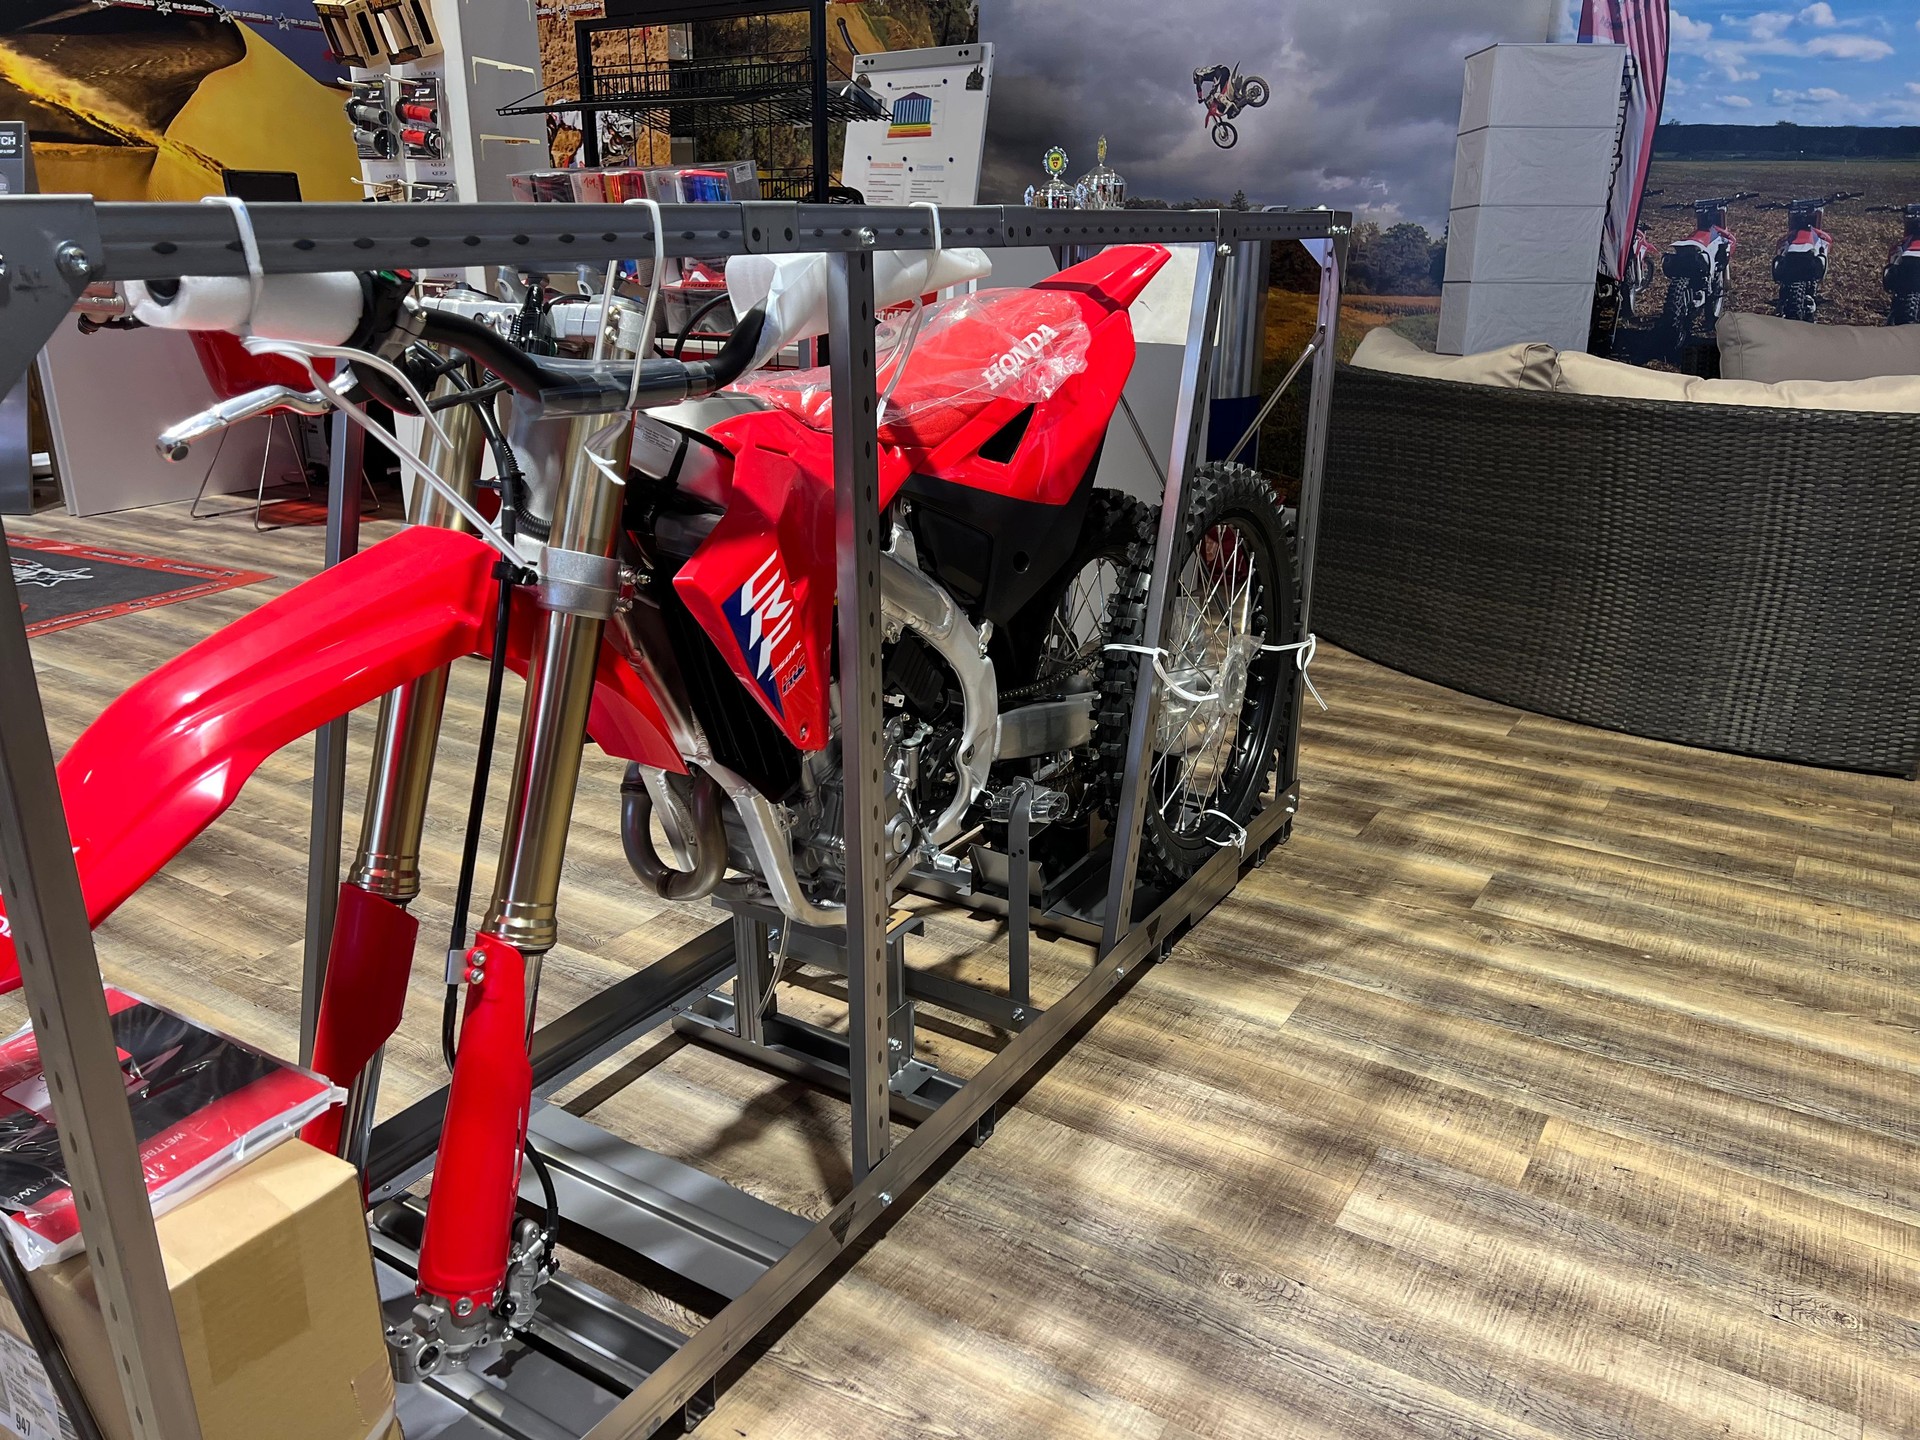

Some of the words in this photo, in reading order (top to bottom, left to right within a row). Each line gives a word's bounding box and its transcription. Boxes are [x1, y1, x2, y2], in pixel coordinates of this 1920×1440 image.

[981, 324, 1060, 391] HONDA
[140, 1132, 187, 1162] WETTBE
[15, 1412, 31, 1437] 947
